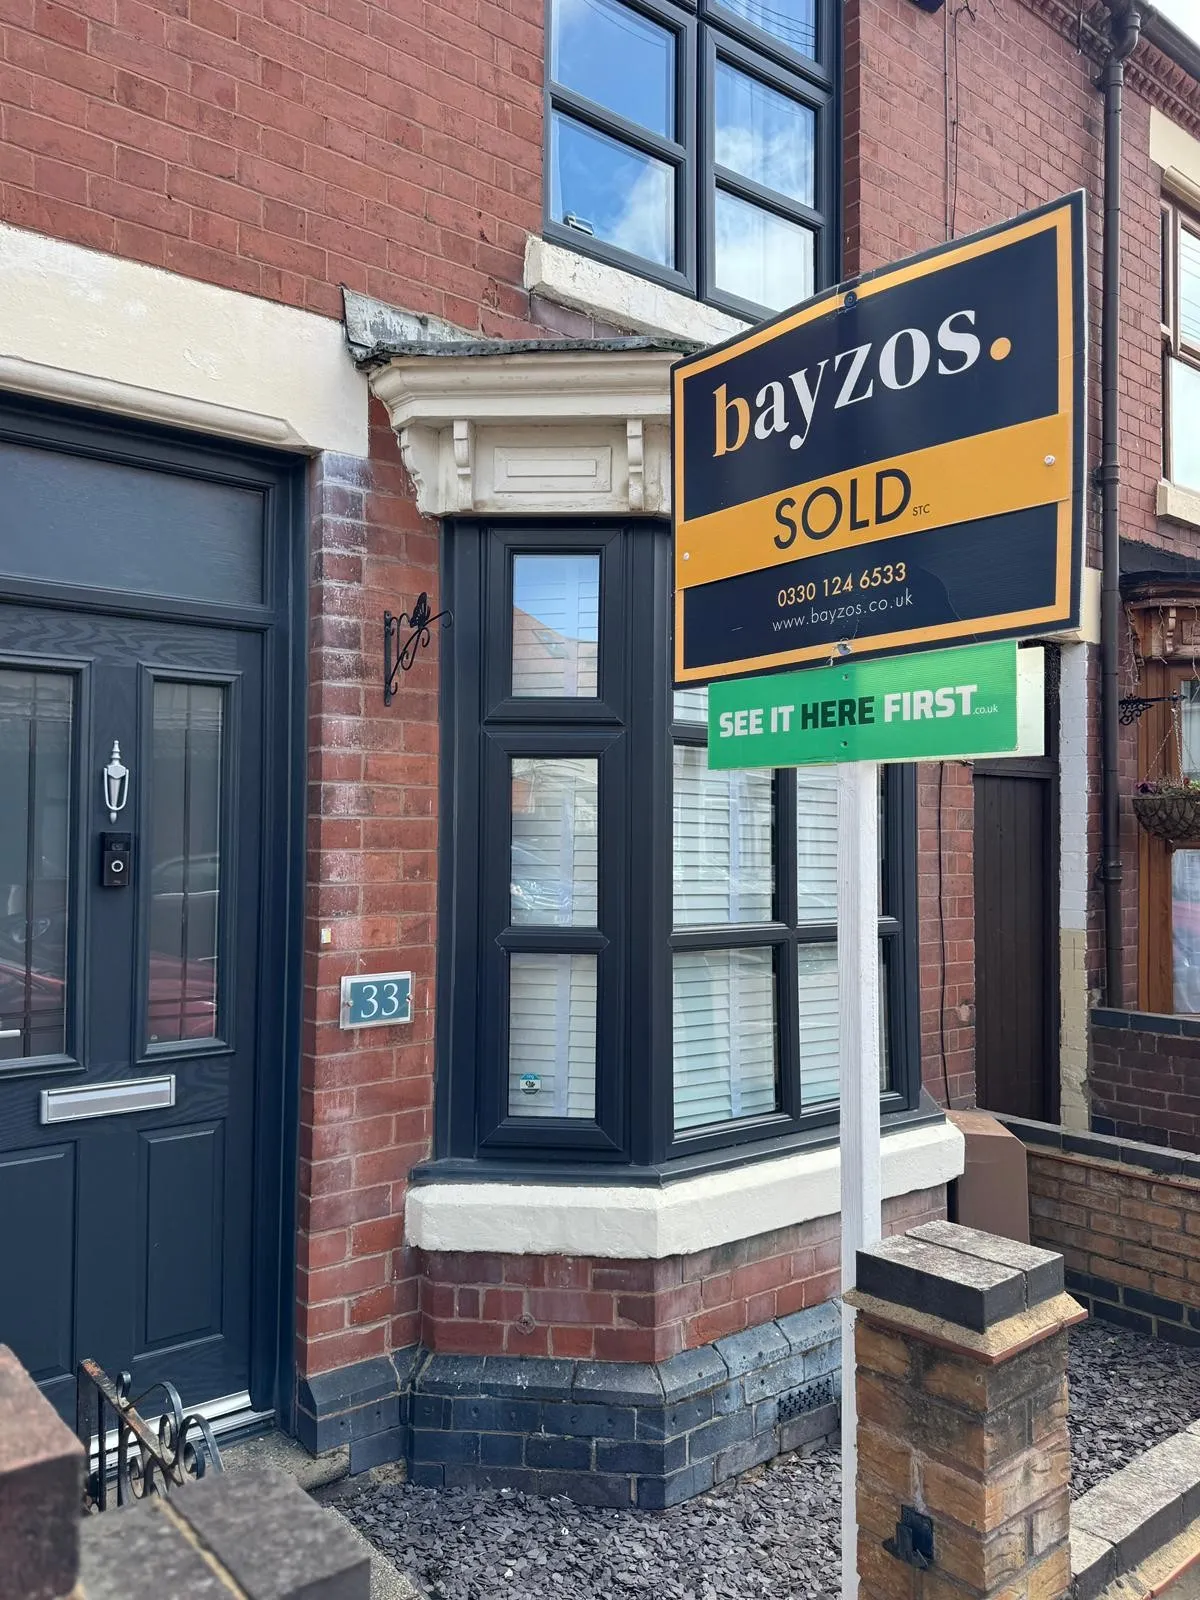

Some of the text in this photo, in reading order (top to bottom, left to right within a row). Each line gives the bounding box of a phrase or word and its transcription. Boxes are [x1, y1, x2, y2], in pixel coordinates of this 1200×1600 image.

[712, 310, 1012, 457] bayzos.
[773, 468, 930, 549] SOLD STC
[777, 562, 907, 607] 0330 124 6533
[772, 587, 913, 631] www.bayzos.co.uk
[719, 708, 763, 738] SEE
[770, 705, 795, 733] IT
[801, 695, 875, 730] HERE
[361, 982, 399, 1018] 33
